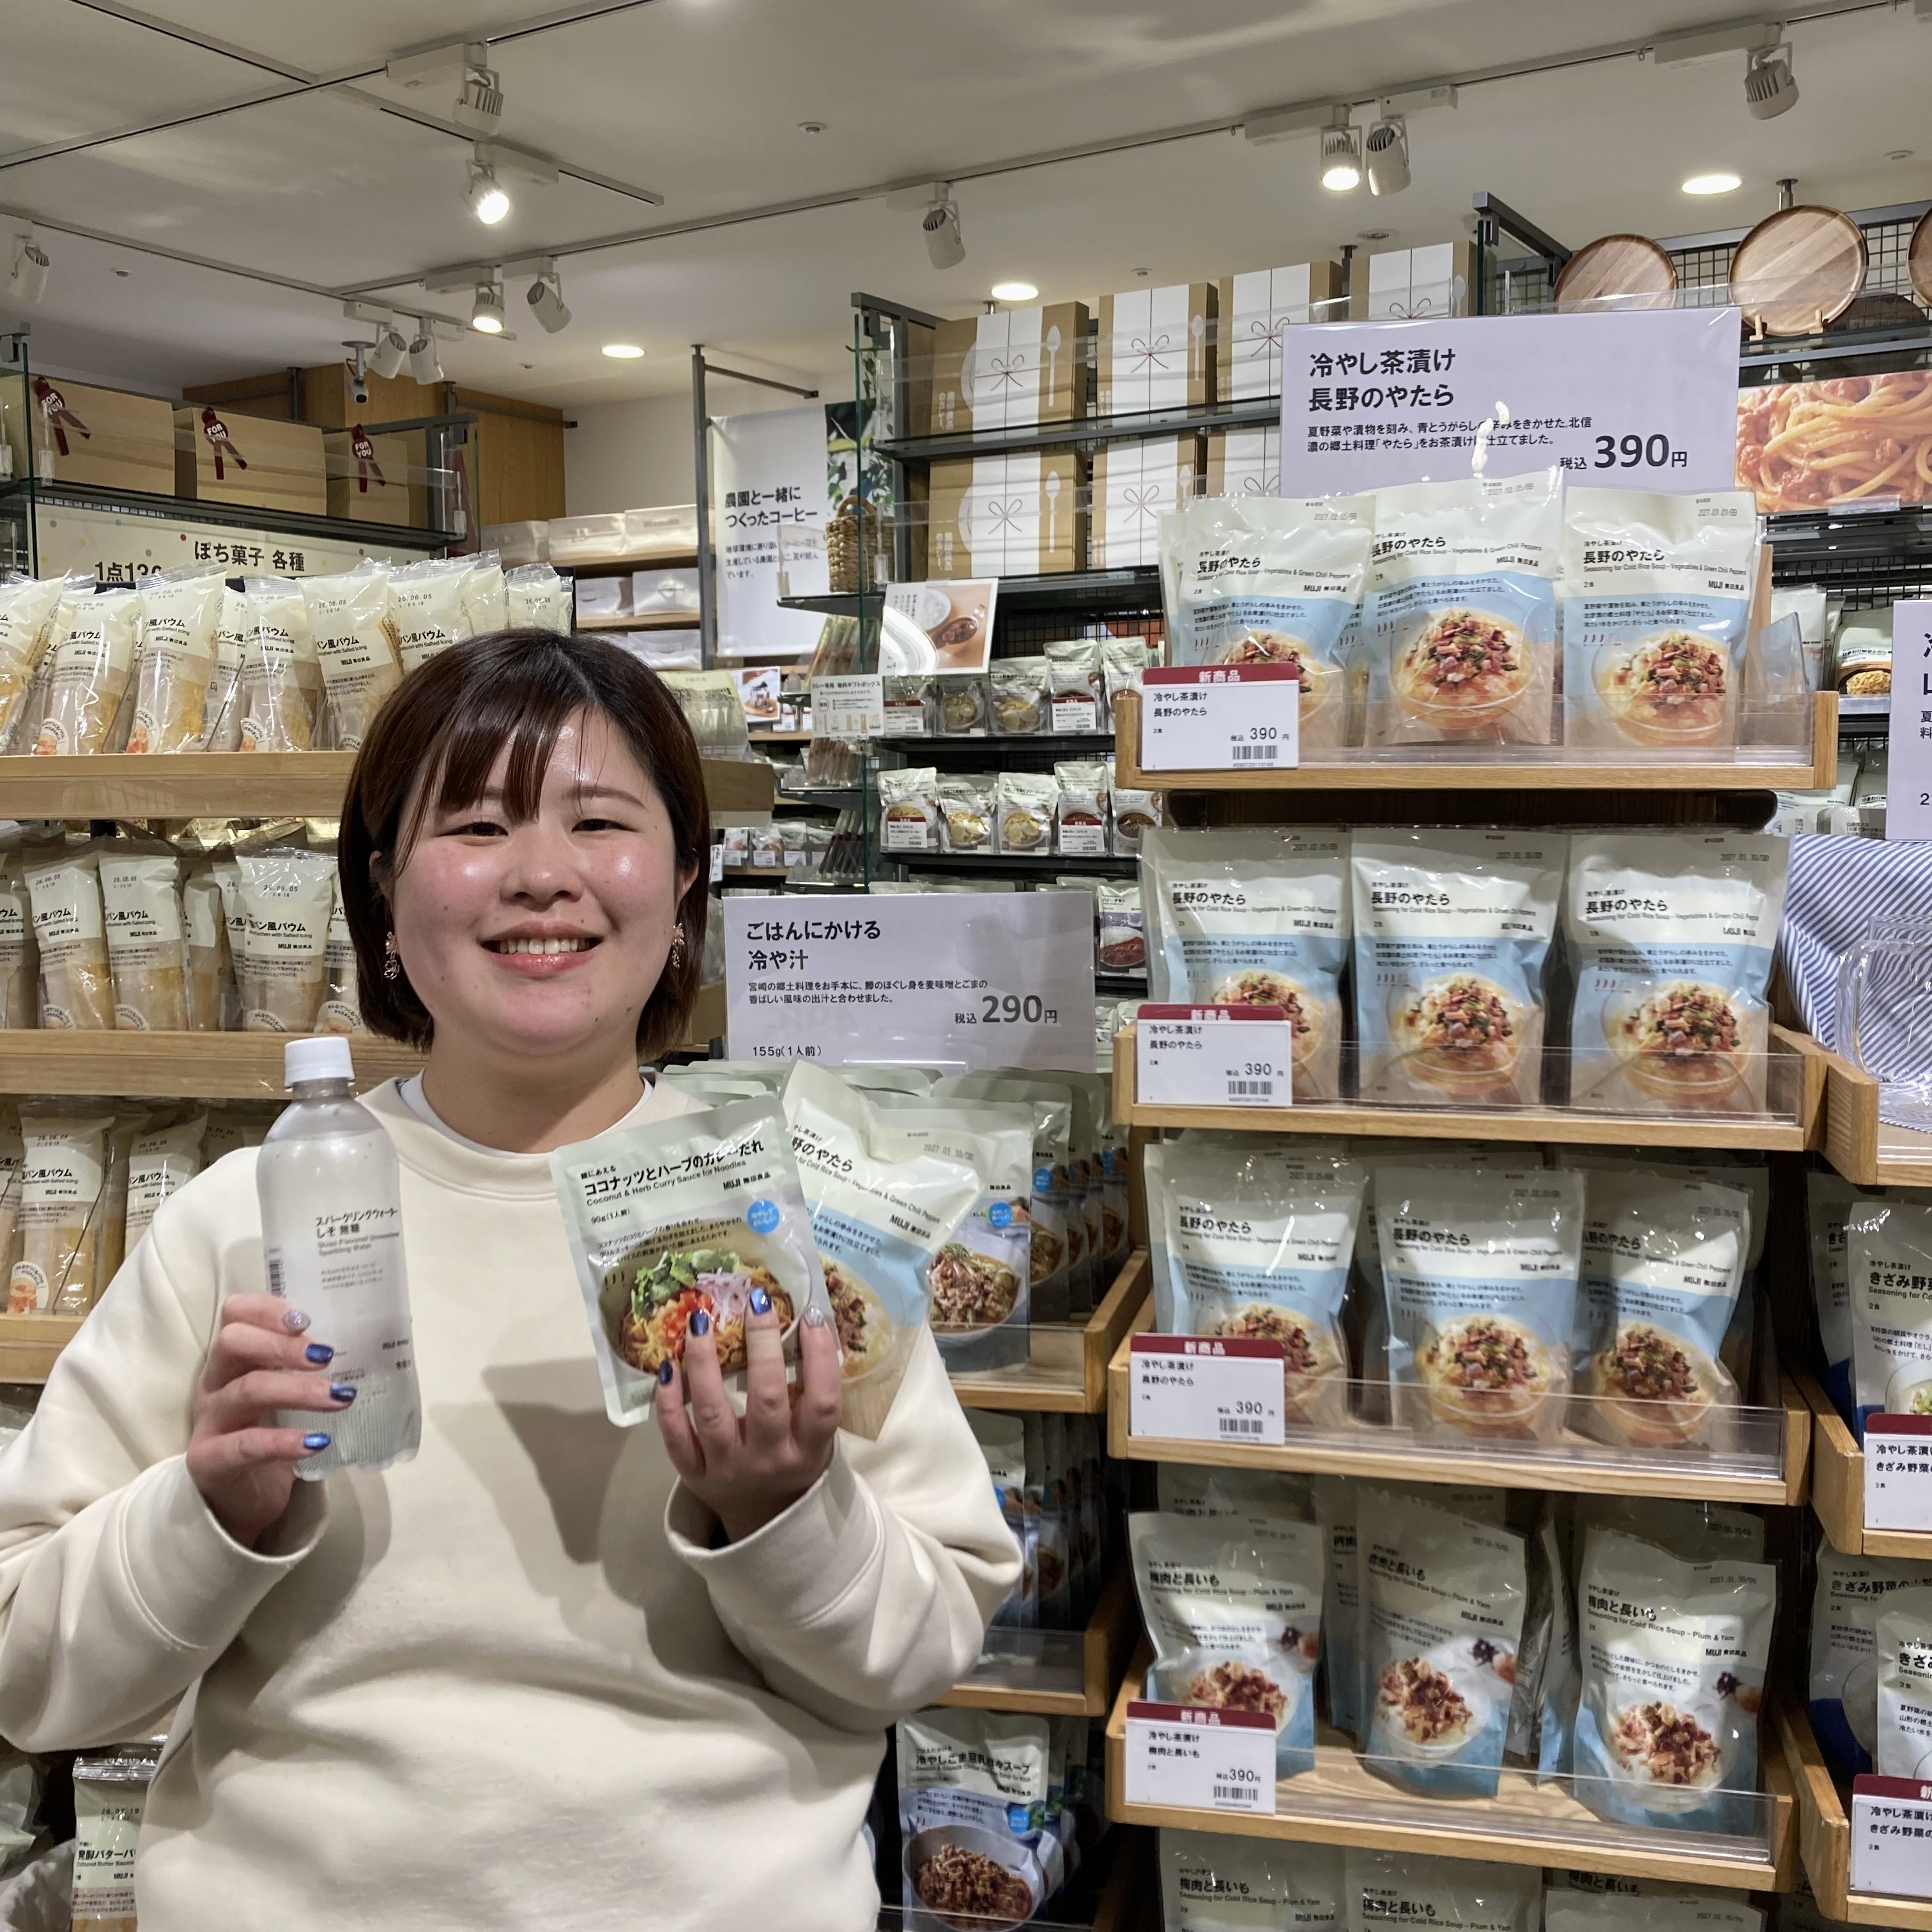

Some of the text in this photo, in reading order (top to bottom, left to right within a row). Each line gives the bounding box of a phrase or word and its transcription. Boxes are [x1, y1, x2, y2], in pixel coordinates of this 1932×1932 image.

[1308, 349, 1456, 378] 冷やし茶漬け
[1308, 383, 1455, 412] 長野のやたら
[206, 424, 223, 436] FOR
[210, 431, 227, 441] YOU
[355, 441, 369, 450] FOR
[1560, 433, 1687, 470] 税込 390円
[356, 448, 372, 457] YOU
[725, 486, 801, 508] 農園と一緒に
[725, 507, 817, 528] つくったコーヒー
[1372, 537, 1446, 557] 長野のやたら
[194, 541, 304, 571] ぽち菓子 各種
[1584, 549, 1664, 564] 長野のやたら
[1198, 557, 1261, 573] 長野のやたら
[1199, 670, 1241, 683] 新商品
[1154, 692, 1208, 702] 冷やし茶漬け
[1154, 707, 1207, 717] 長野のやたら
[1250, 727, 1277, 740] 390
[1173, 892, 1245, 905] 長野のやたら
[1372, 892, 1450, 905] 長野のやたら
[1586, 900, 1667, 914] 長野のやたら
[747, 921, 881, 940] ごはんにかける
[748, 949, 809, 970] 冷や汁
[749, 993, 894, 1004] 香ばしい風味の出汁と合わせました。
[954, 995, 1057, 1024] 税込 290円
[1191, 1009, 1230, 1020] 新商品
[1149, 1025, 1202, 1034] 冷やし茶漬け
[1150, 1041, 1202, 1049] 長野のやたら
[1245, 1063, 1271, 1075] 390
[791, 1135, 852, 1172] 野のやたら
[586, 1192, 622, 1206] Coconut
[632, 1184, 652, 1195] Herb
[653, 1178, 675, 1192] Curry
[677, 1172, 702, 1184] Sauce
[703, 1169, 713, 1177] for
[714, 1160, 746, 1174] Noodles
[723, 1178, 741, 1191] MUJI
[806, 1160, 820, 1170] Cold
[820, 1166, 832, 1175] Rice
[832, 1170, 847, 1183] Soup
[890, 1195, 907, 1208] Green
[890, 1215, 910, 1230] MUJI
[317, 1227, 336, 1238] しそ
[1393, 1228, 1470, 1245] 長野のやたら
[1869, 1261, 1910, 1270] 冷やし茶漬け
[1684, 1276, 1701, 1285] MUJI
[1869, 1286, 1907, 1298] Seasoning
[1236, 1401, 1262, 1414] 390
[1630, 1619, 1646, 1629] Cold
[1648, 1623, 1664, 1632] Rice
[1666, 1626, 1685, 1637] Soup
[1693, 1631, 1711, 1640] Plum
[1705, 1648, 1722, 1657] MUJI
[1229, 1768, 1254, 1782] 390
[1243, 1896, 1257, 1904] Rice
[1410, 1916, 1464, 1929] Cold Rice Soup
